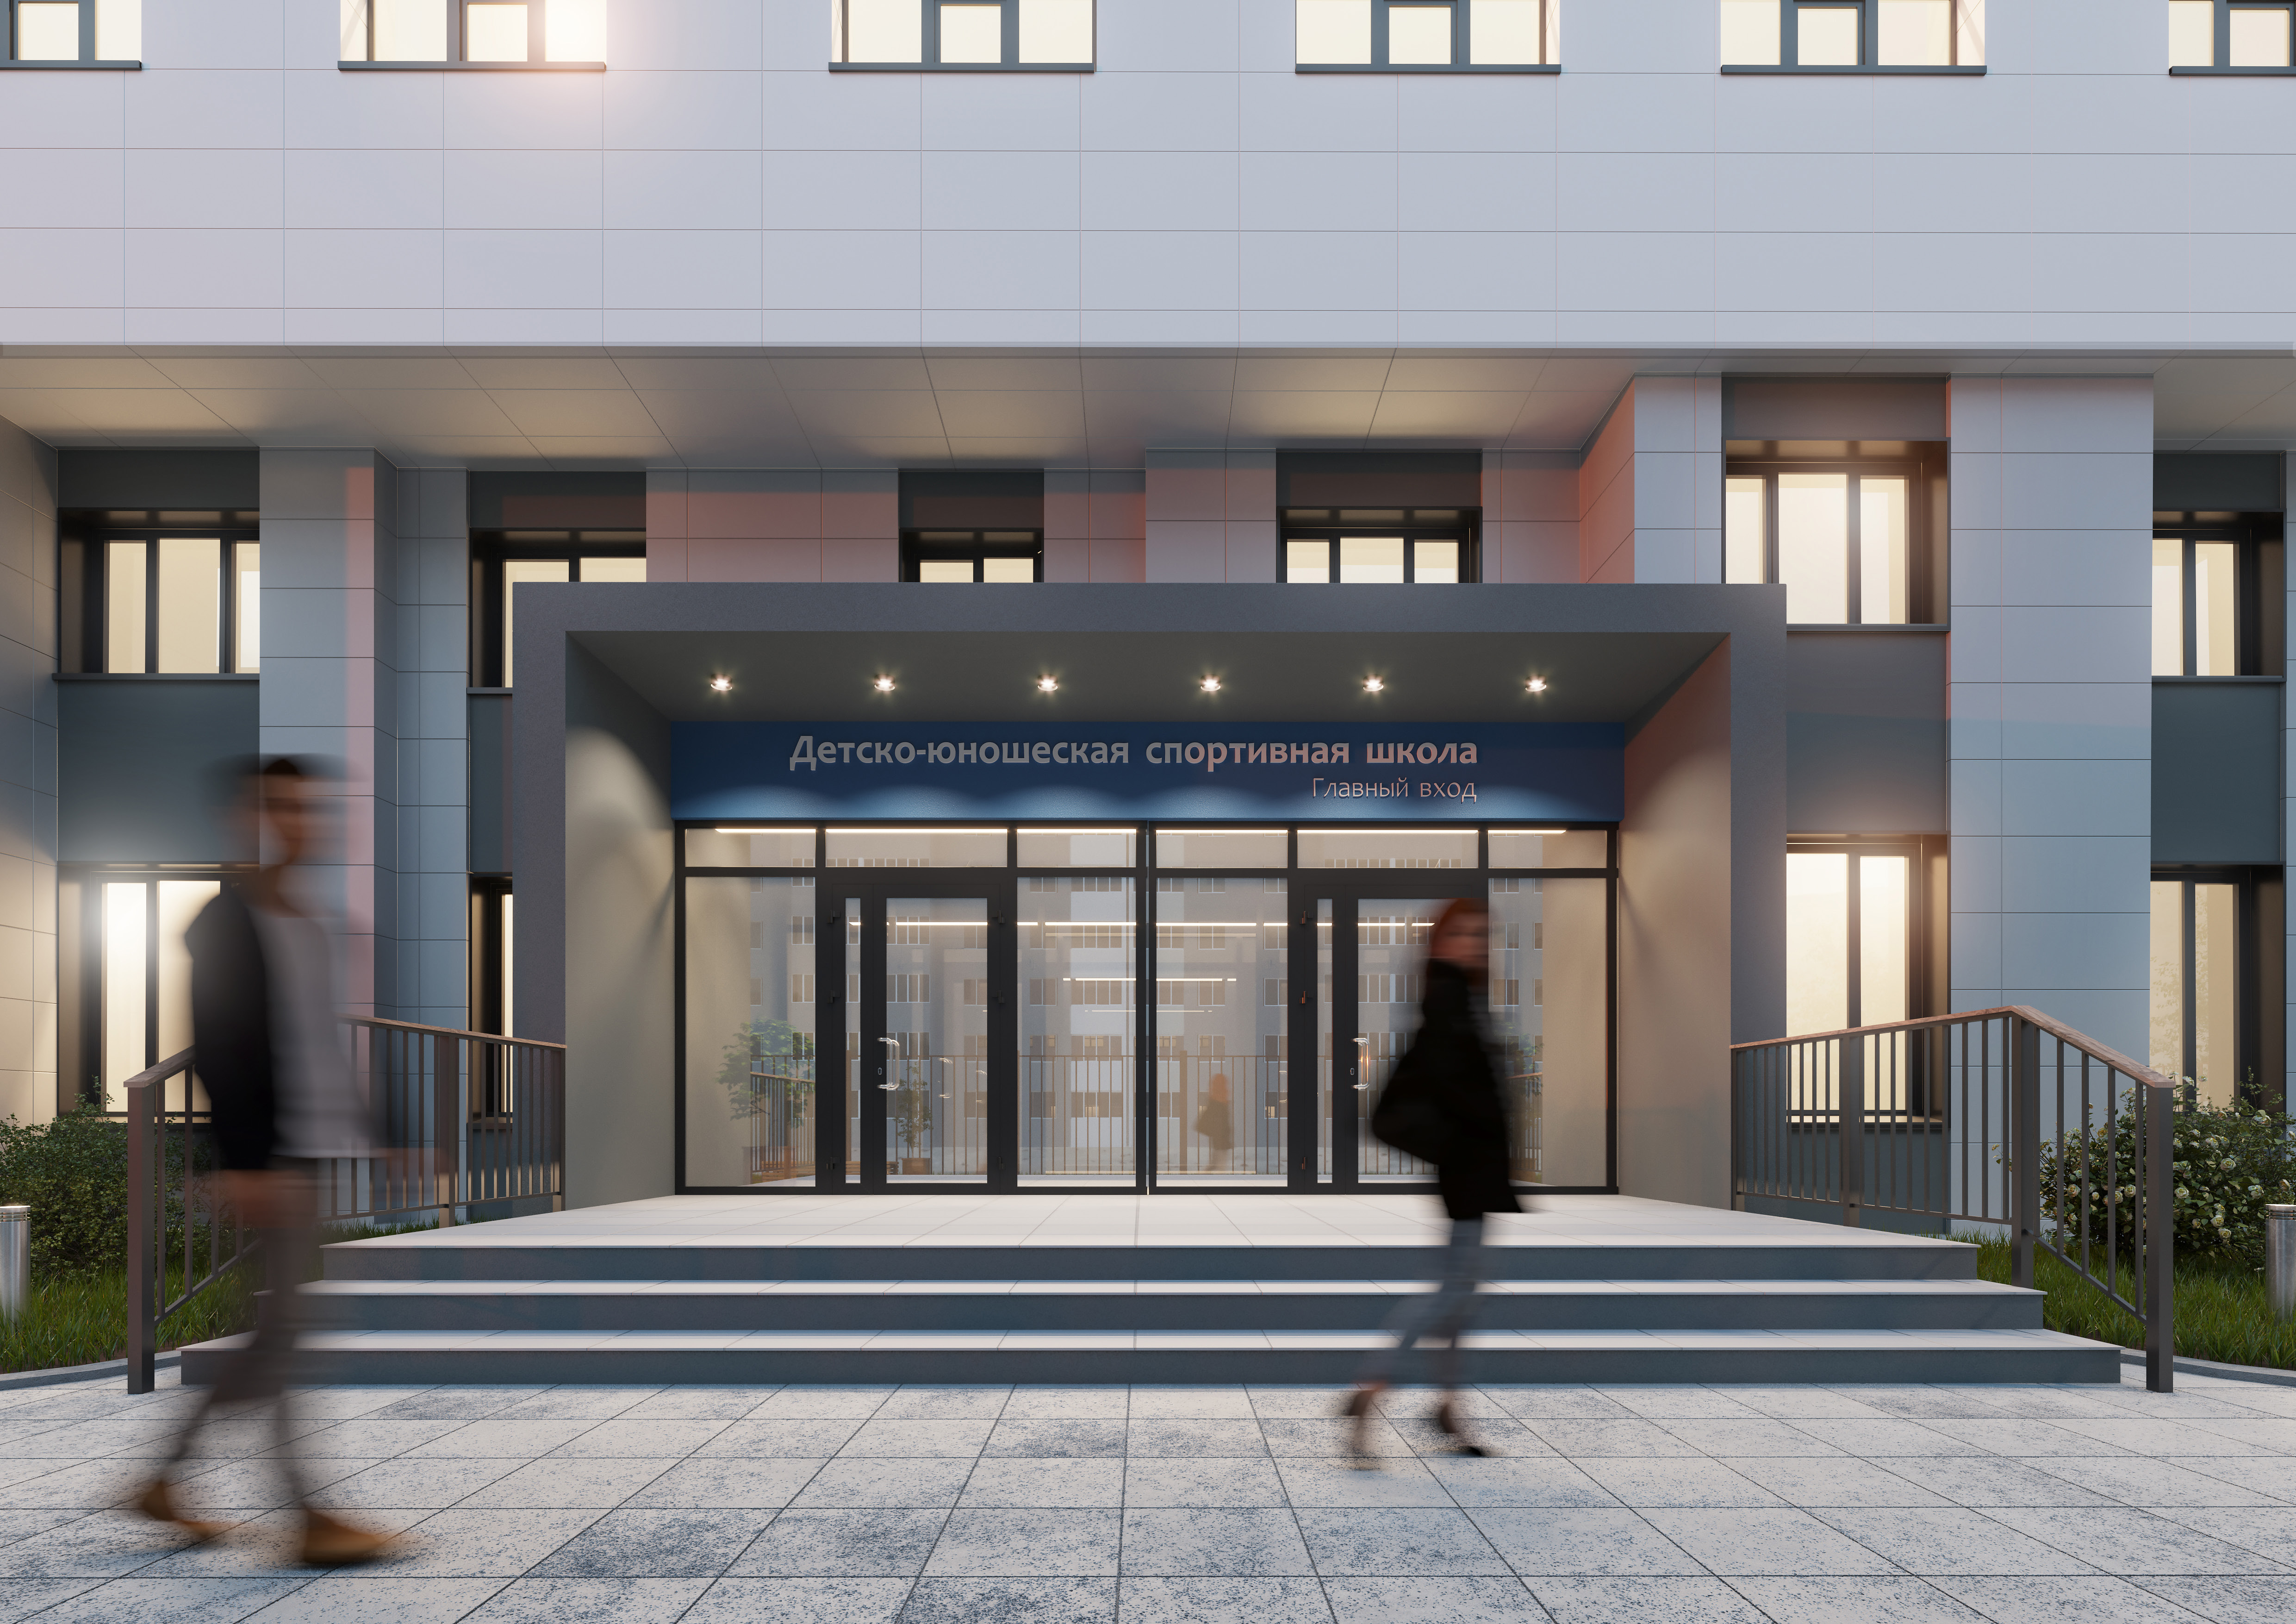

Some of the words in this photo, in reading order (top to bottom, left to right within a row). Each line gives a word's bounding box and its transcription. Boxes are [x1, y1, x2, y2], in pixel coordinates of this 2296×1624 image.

[790, 735, 1129, 771] Детско-юношеская
[1146, 742, 1350, 772] спортивная
[1367, 742, 1478, 764] школа
[1313, 777, 1409, 798] Главный
[1420, 782, 1477, 804] вход
